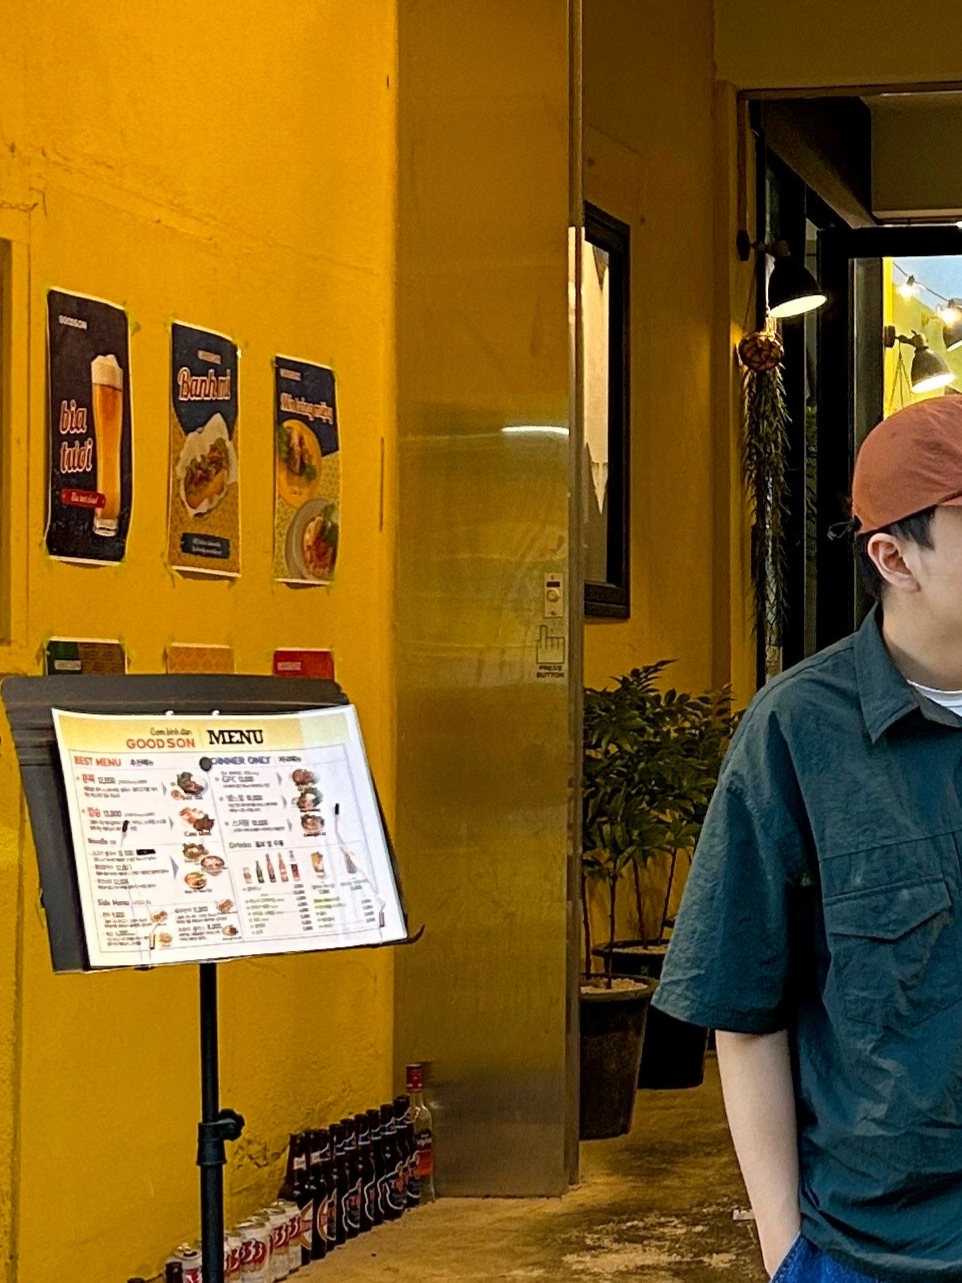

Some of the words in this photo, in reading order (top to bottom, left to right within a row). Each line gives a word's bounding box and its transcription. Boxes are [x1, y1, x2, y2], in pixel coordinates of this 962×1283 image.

[59, 399, 88, 435] bia
[207, 729, 264, 745] MENU
[74, 756, 93, 766] BEST
[95, 756, 122, 767] MENU
